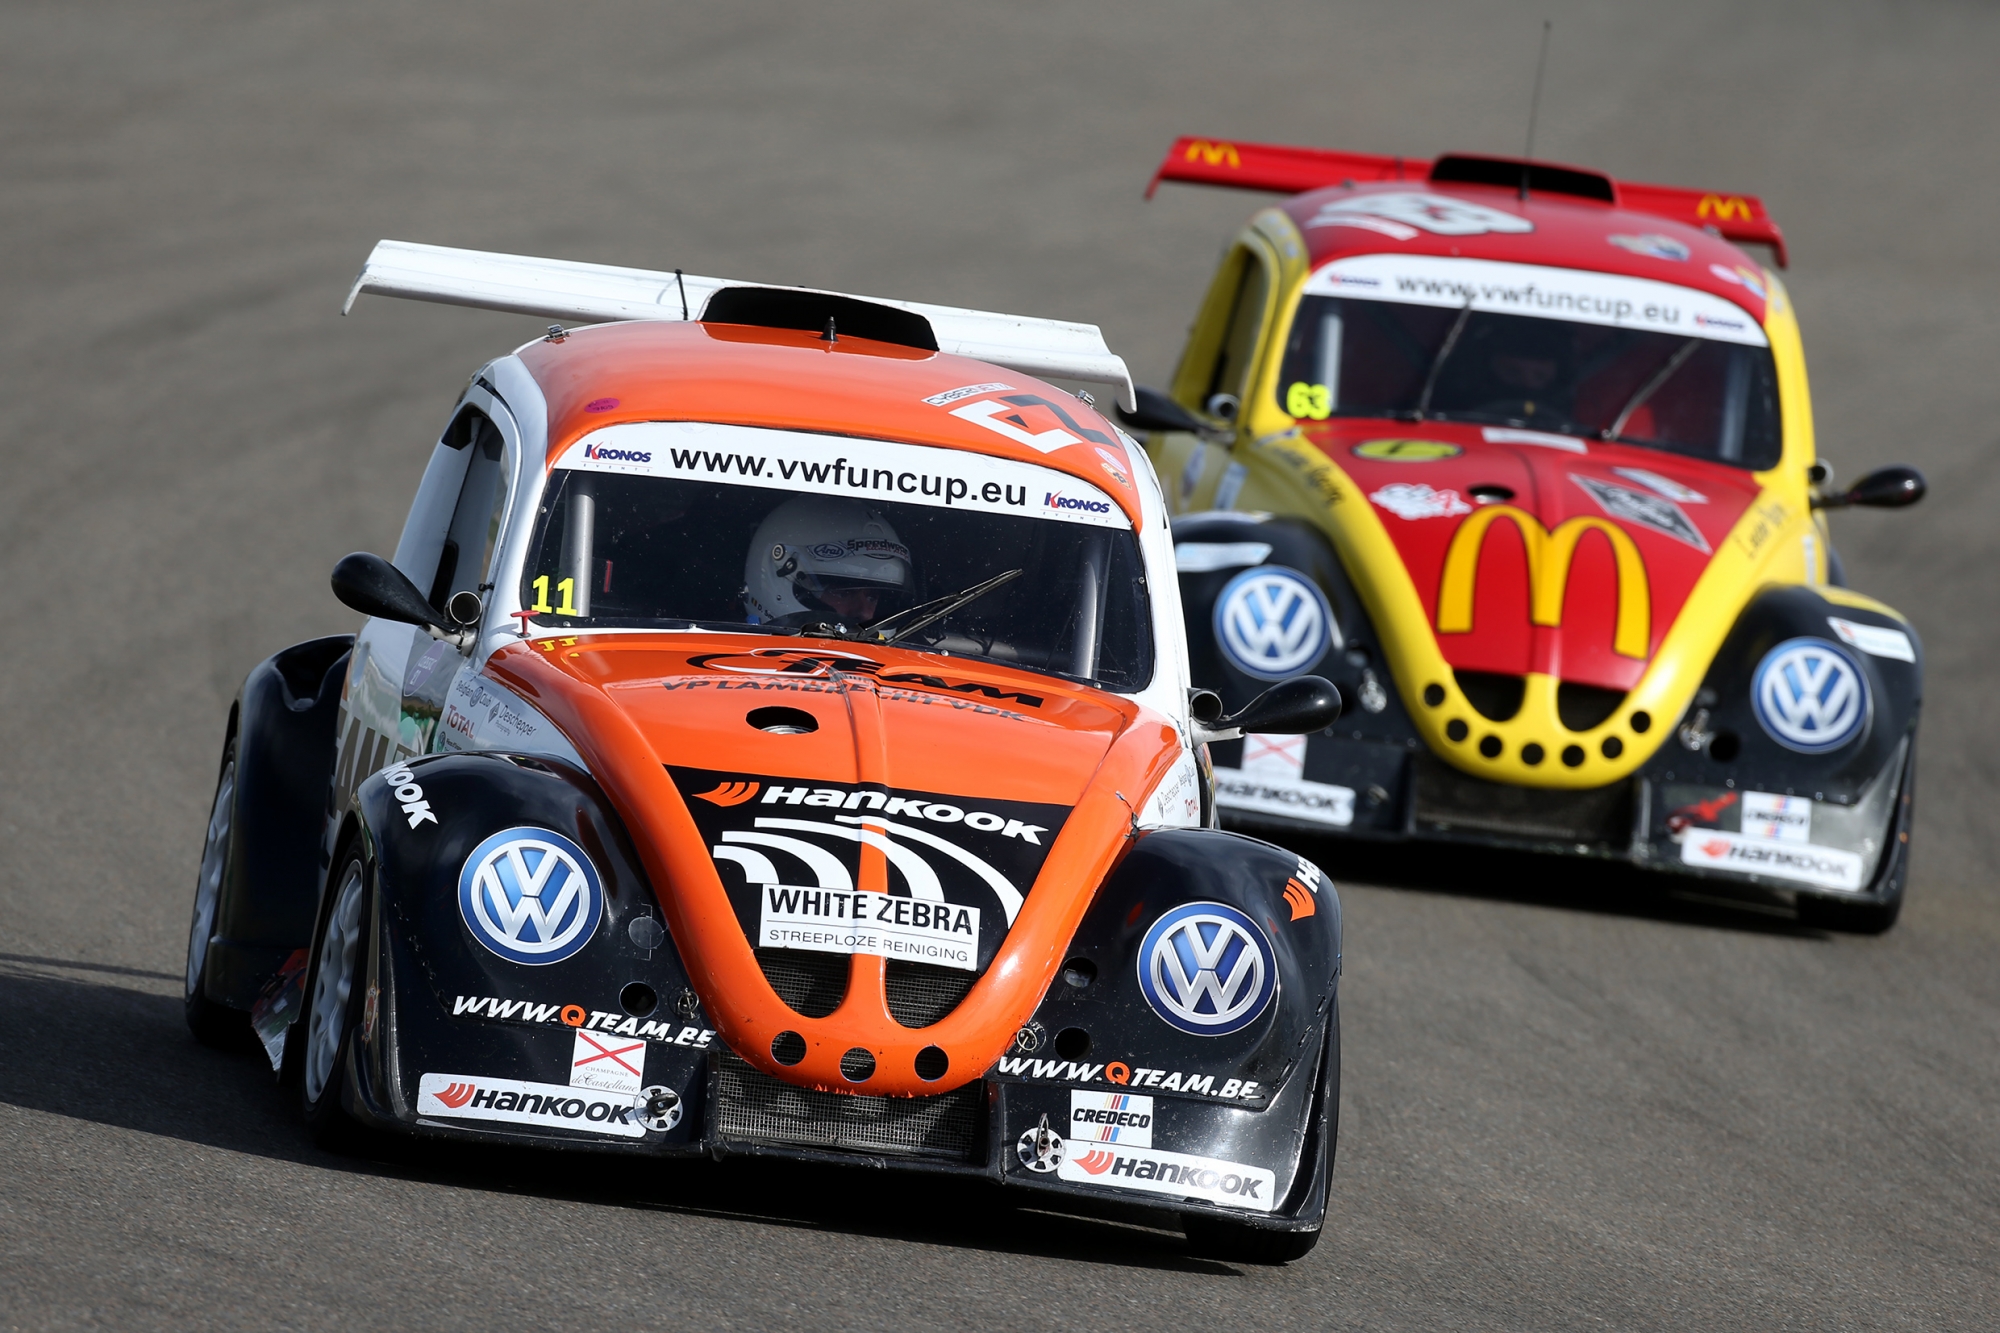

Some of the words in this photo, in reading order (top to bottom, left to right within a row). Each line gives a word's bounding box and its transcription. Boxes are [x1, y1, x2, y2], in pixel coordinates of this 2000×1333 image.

[1393, 273, 1680, 325] www.vwfuncup.eu
[1287, 381, 1332, 420] 63
[584, 441, 652, 462] KRONOS
[670, 447, 1026, 506] www.vwfuncup.eu
[1043, 490, 1110, 514] KRONOS
[531, 574, 577, 617] 11
[662, 681, 710, 691] VP
[446, 704, 475, 740] TOTAL
[499, 704, 537, 737] Deschepper
[769, 888, 868, 919] WHITE
[877, 897, 972, 935] ZEBRA
[769, 929, 877, 948] STREEPLOZE
[883, 939, 968, 962] REINIGING
[452, 995, 716, 1048] WWW.QTEAM.BE
[583, 1072, 638, 1092] Castellane
[585, 1066, 629, 1077] CHAMPAGNE
[998, 1056, 1259, 1100] WWW.QTEAM.BE
[1072, 1108, 1151, 1128] CREDECO
